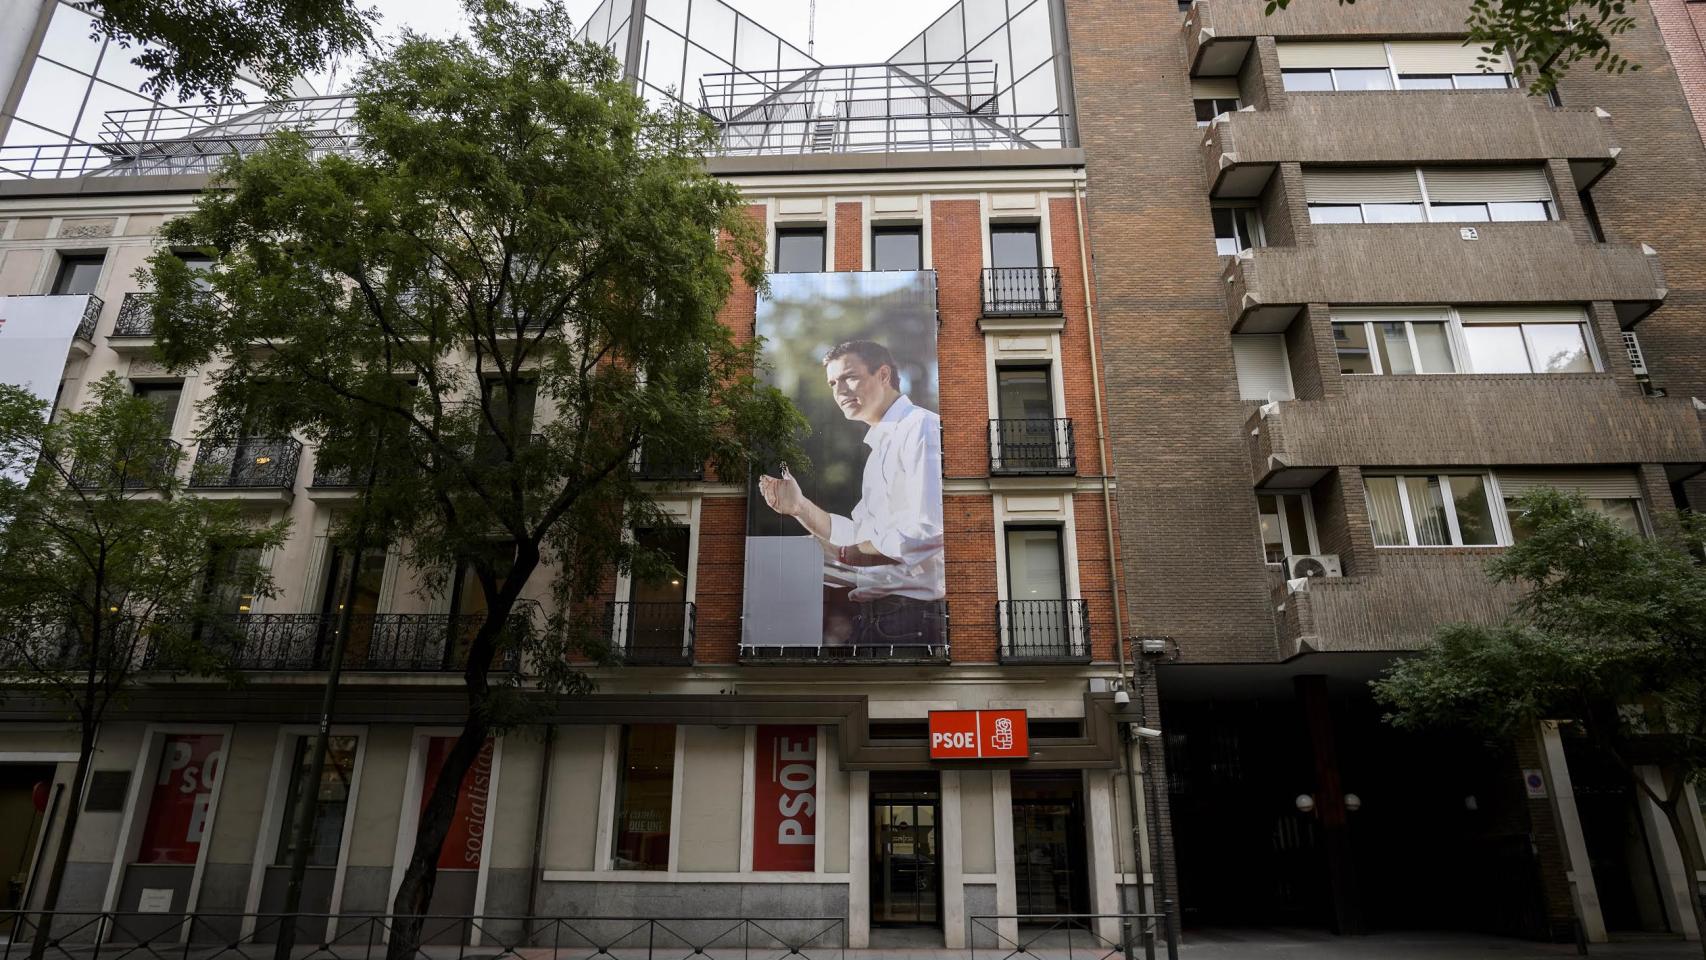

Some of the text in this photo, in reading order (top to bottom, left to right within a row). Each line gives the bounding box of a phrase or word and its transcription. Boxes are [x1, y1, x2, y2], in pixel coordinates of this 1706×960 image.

[778, 736, 818, 845] PSOE
[932, 732, 975, 749] PSOE
[465, 740, 493, 864] socialistas
